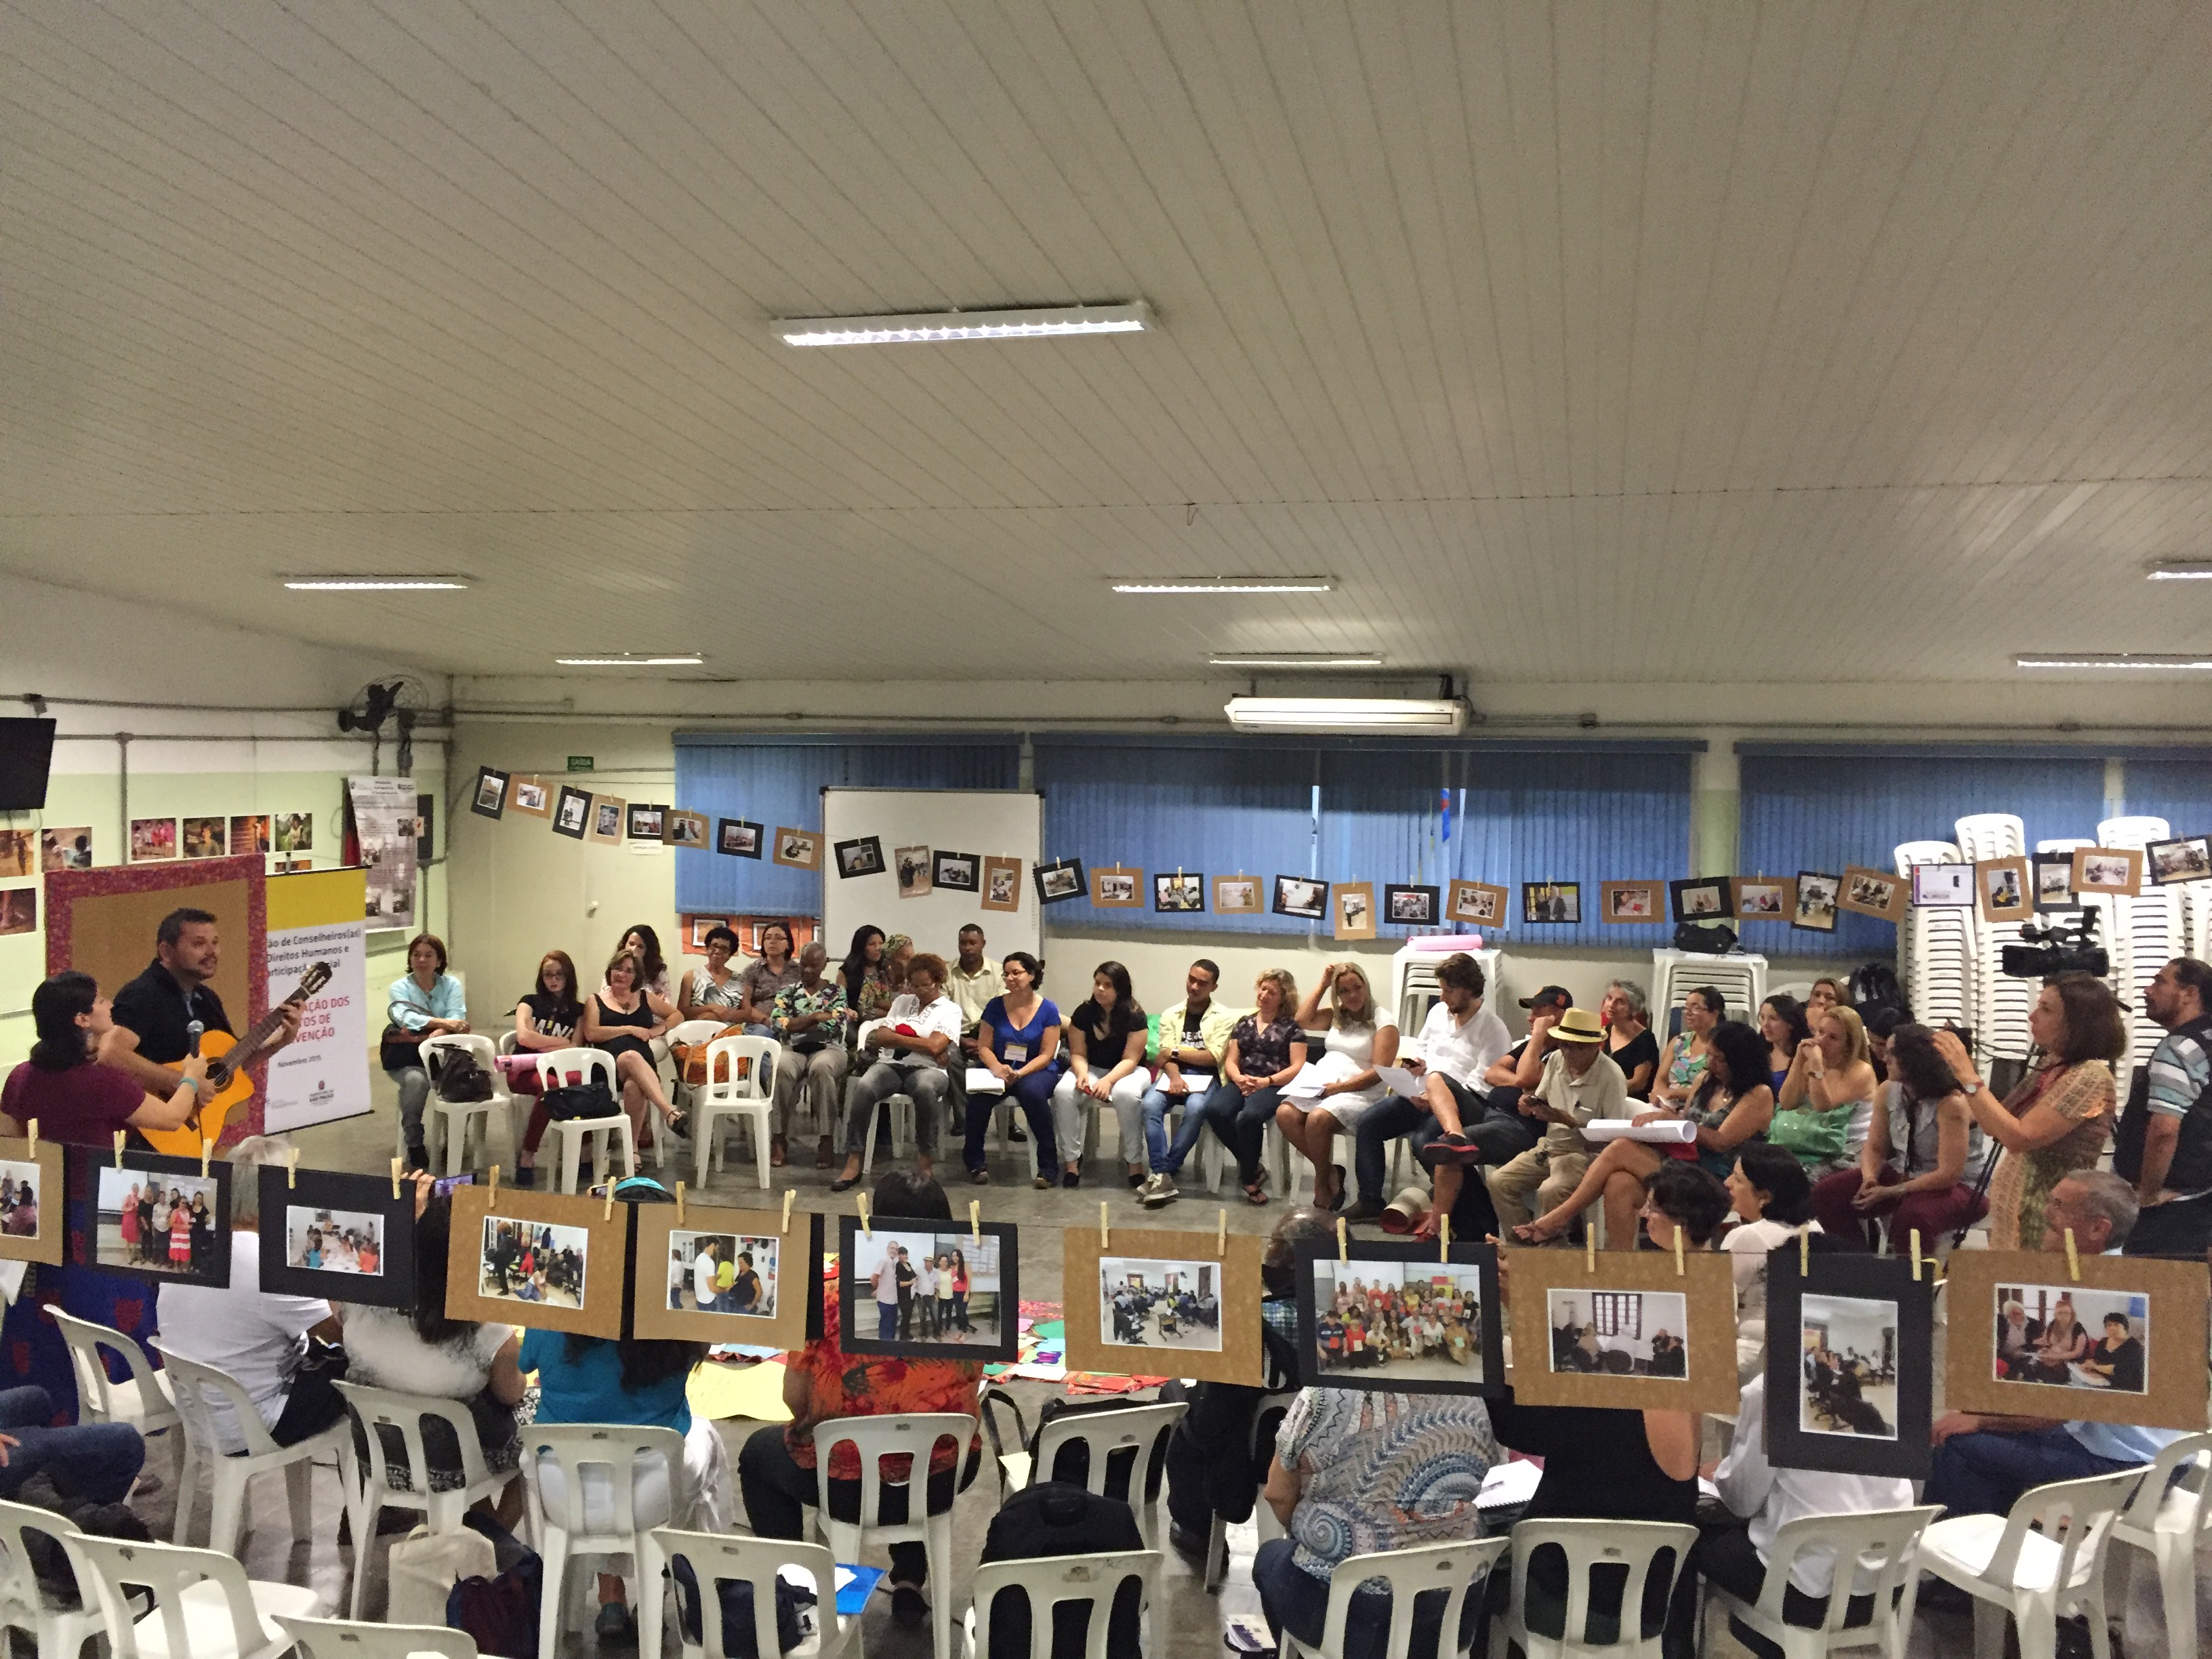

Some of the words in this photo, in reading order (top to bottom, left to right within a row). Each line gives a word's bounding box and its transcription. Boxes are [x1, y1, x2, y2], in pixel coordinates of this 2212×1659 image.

[267, 939, 279, 948] ão
[281, 937, 291, 947] de
[293, 928, 361, 945] Conselheiros(as)
[267, 951, 299, 962] Direitos
[302, 946, 342, 958] Humanos
[331, 996, 350, 1008] DOS
[319, 1013, 331, 1025] DE
